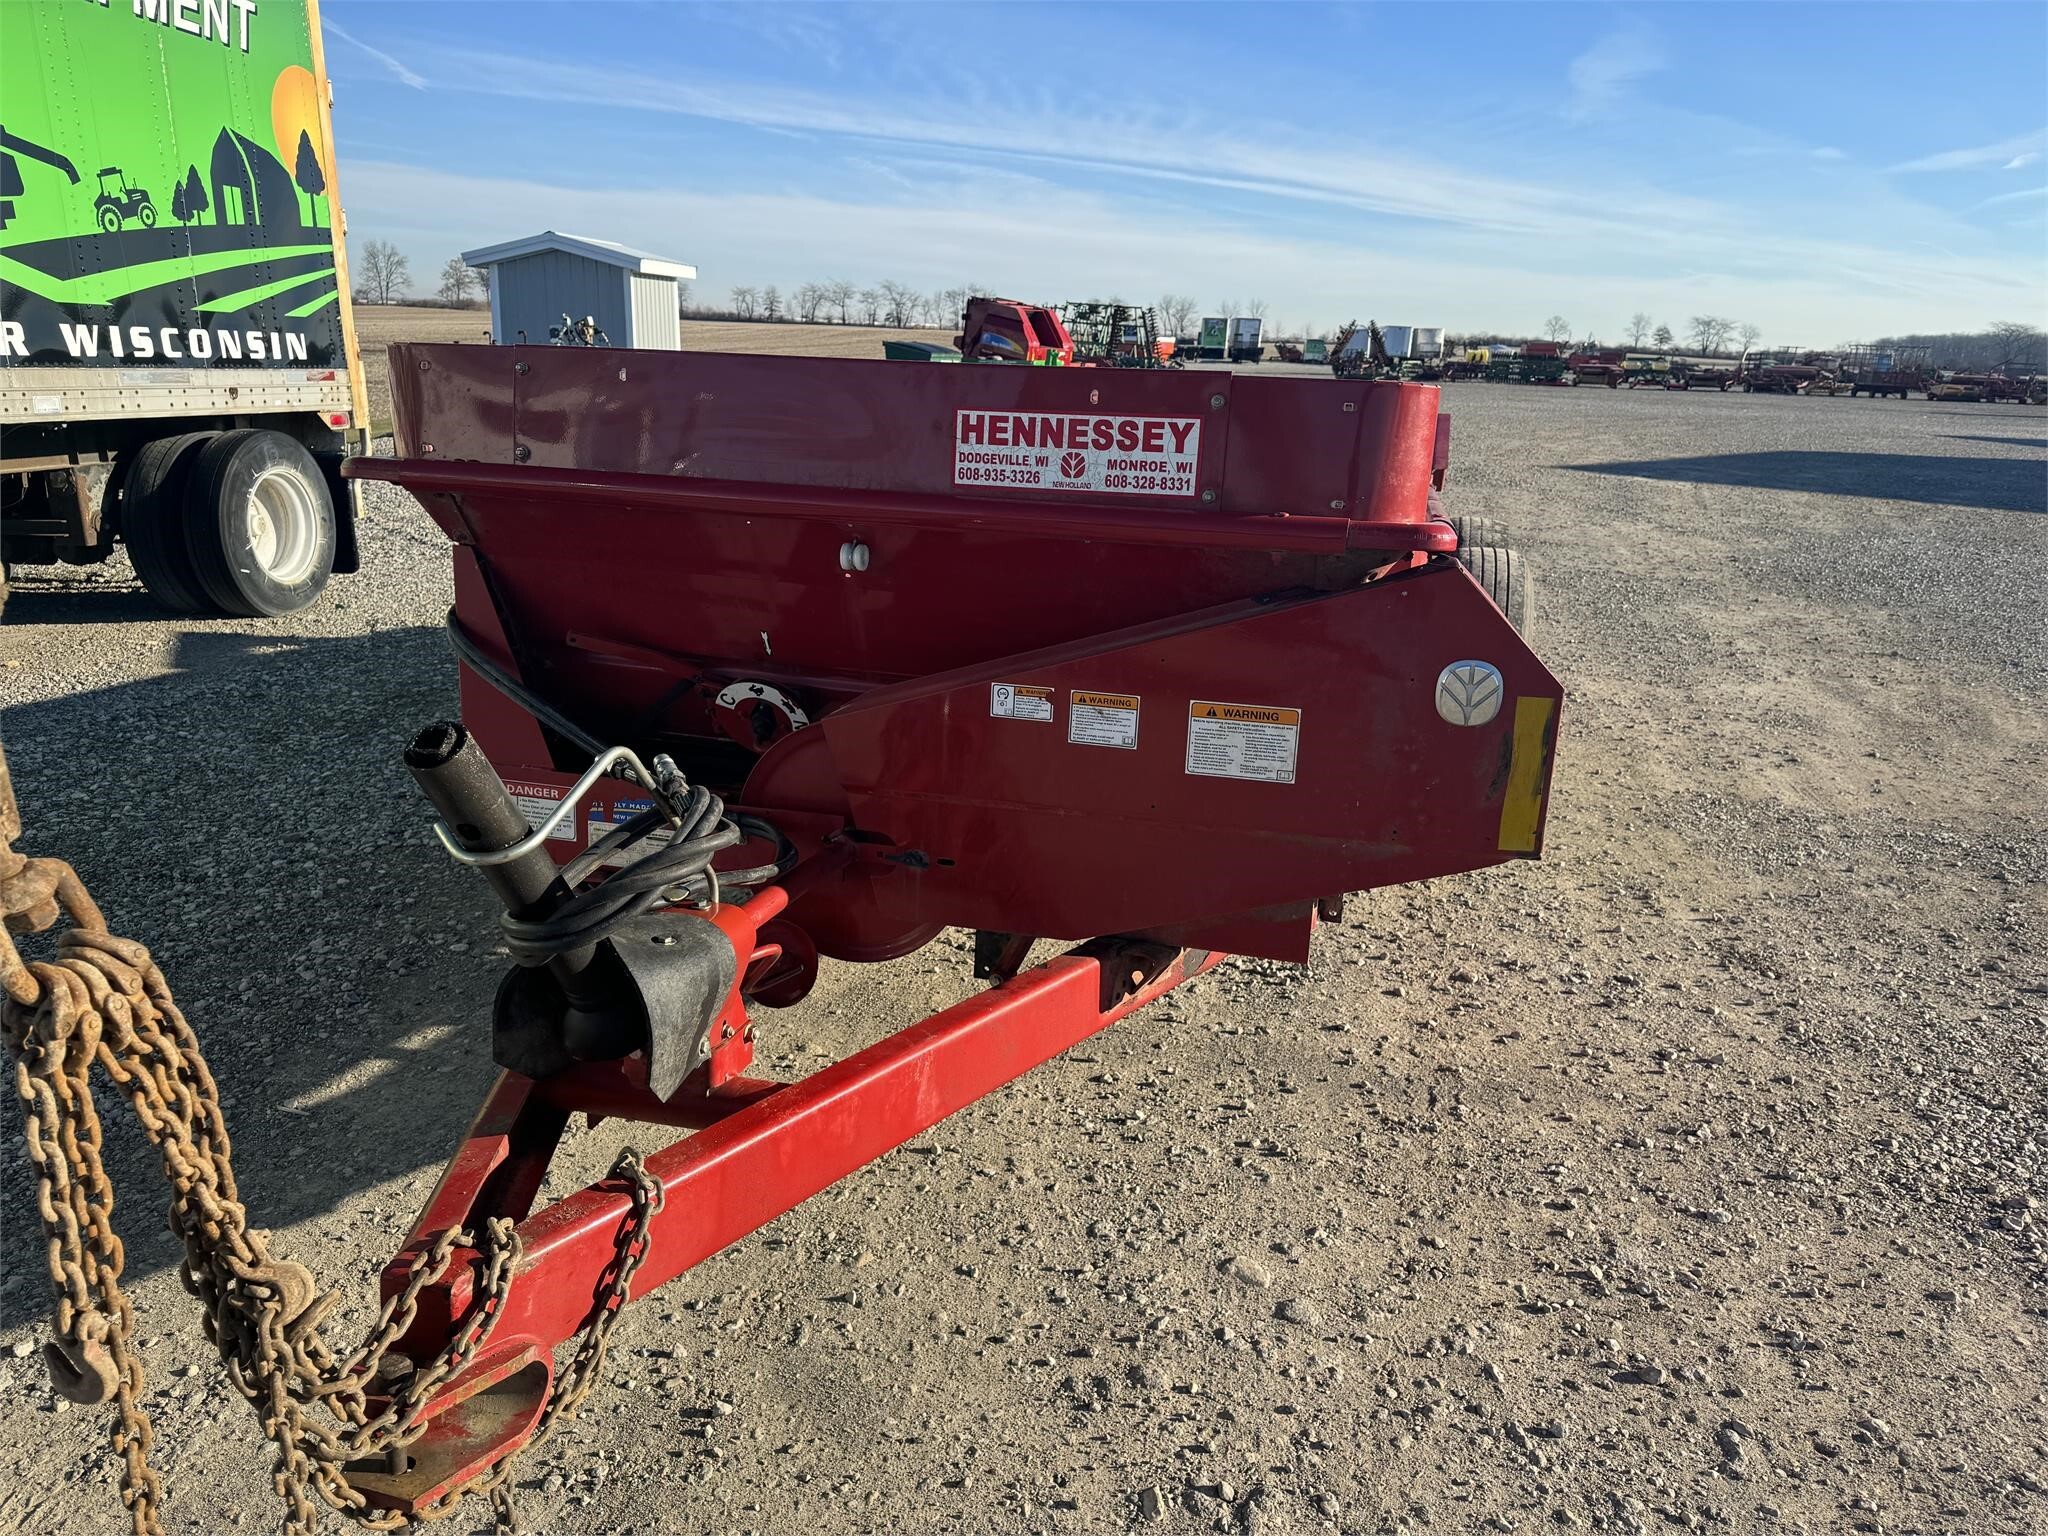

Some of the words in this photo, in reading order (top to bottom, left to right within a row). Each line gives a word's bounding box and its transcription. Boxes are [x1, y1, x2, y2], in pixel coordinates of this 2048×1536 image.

[59, 323, 308, 360] WISCONSIN
[960, 414, 1196, 453] HENNESSEY
[958, 452, 1032, 467] DODGEVILLE,
[1035, 456, 1049, 467] WI
[1107, 459, 1171, 475] MONROE,
[1176, 462, 1193, 474] WI
[958, 467, 1041, 484] 608-935-3326
[1104, 474, 1191, 491] 608-328-8331
[720, 693, 736, 706] C
[1088, 695, 1132, 708] WARNING
[1223, 708, 1280, 722] WARNING
[506, 784, 559, 799] DANGER
